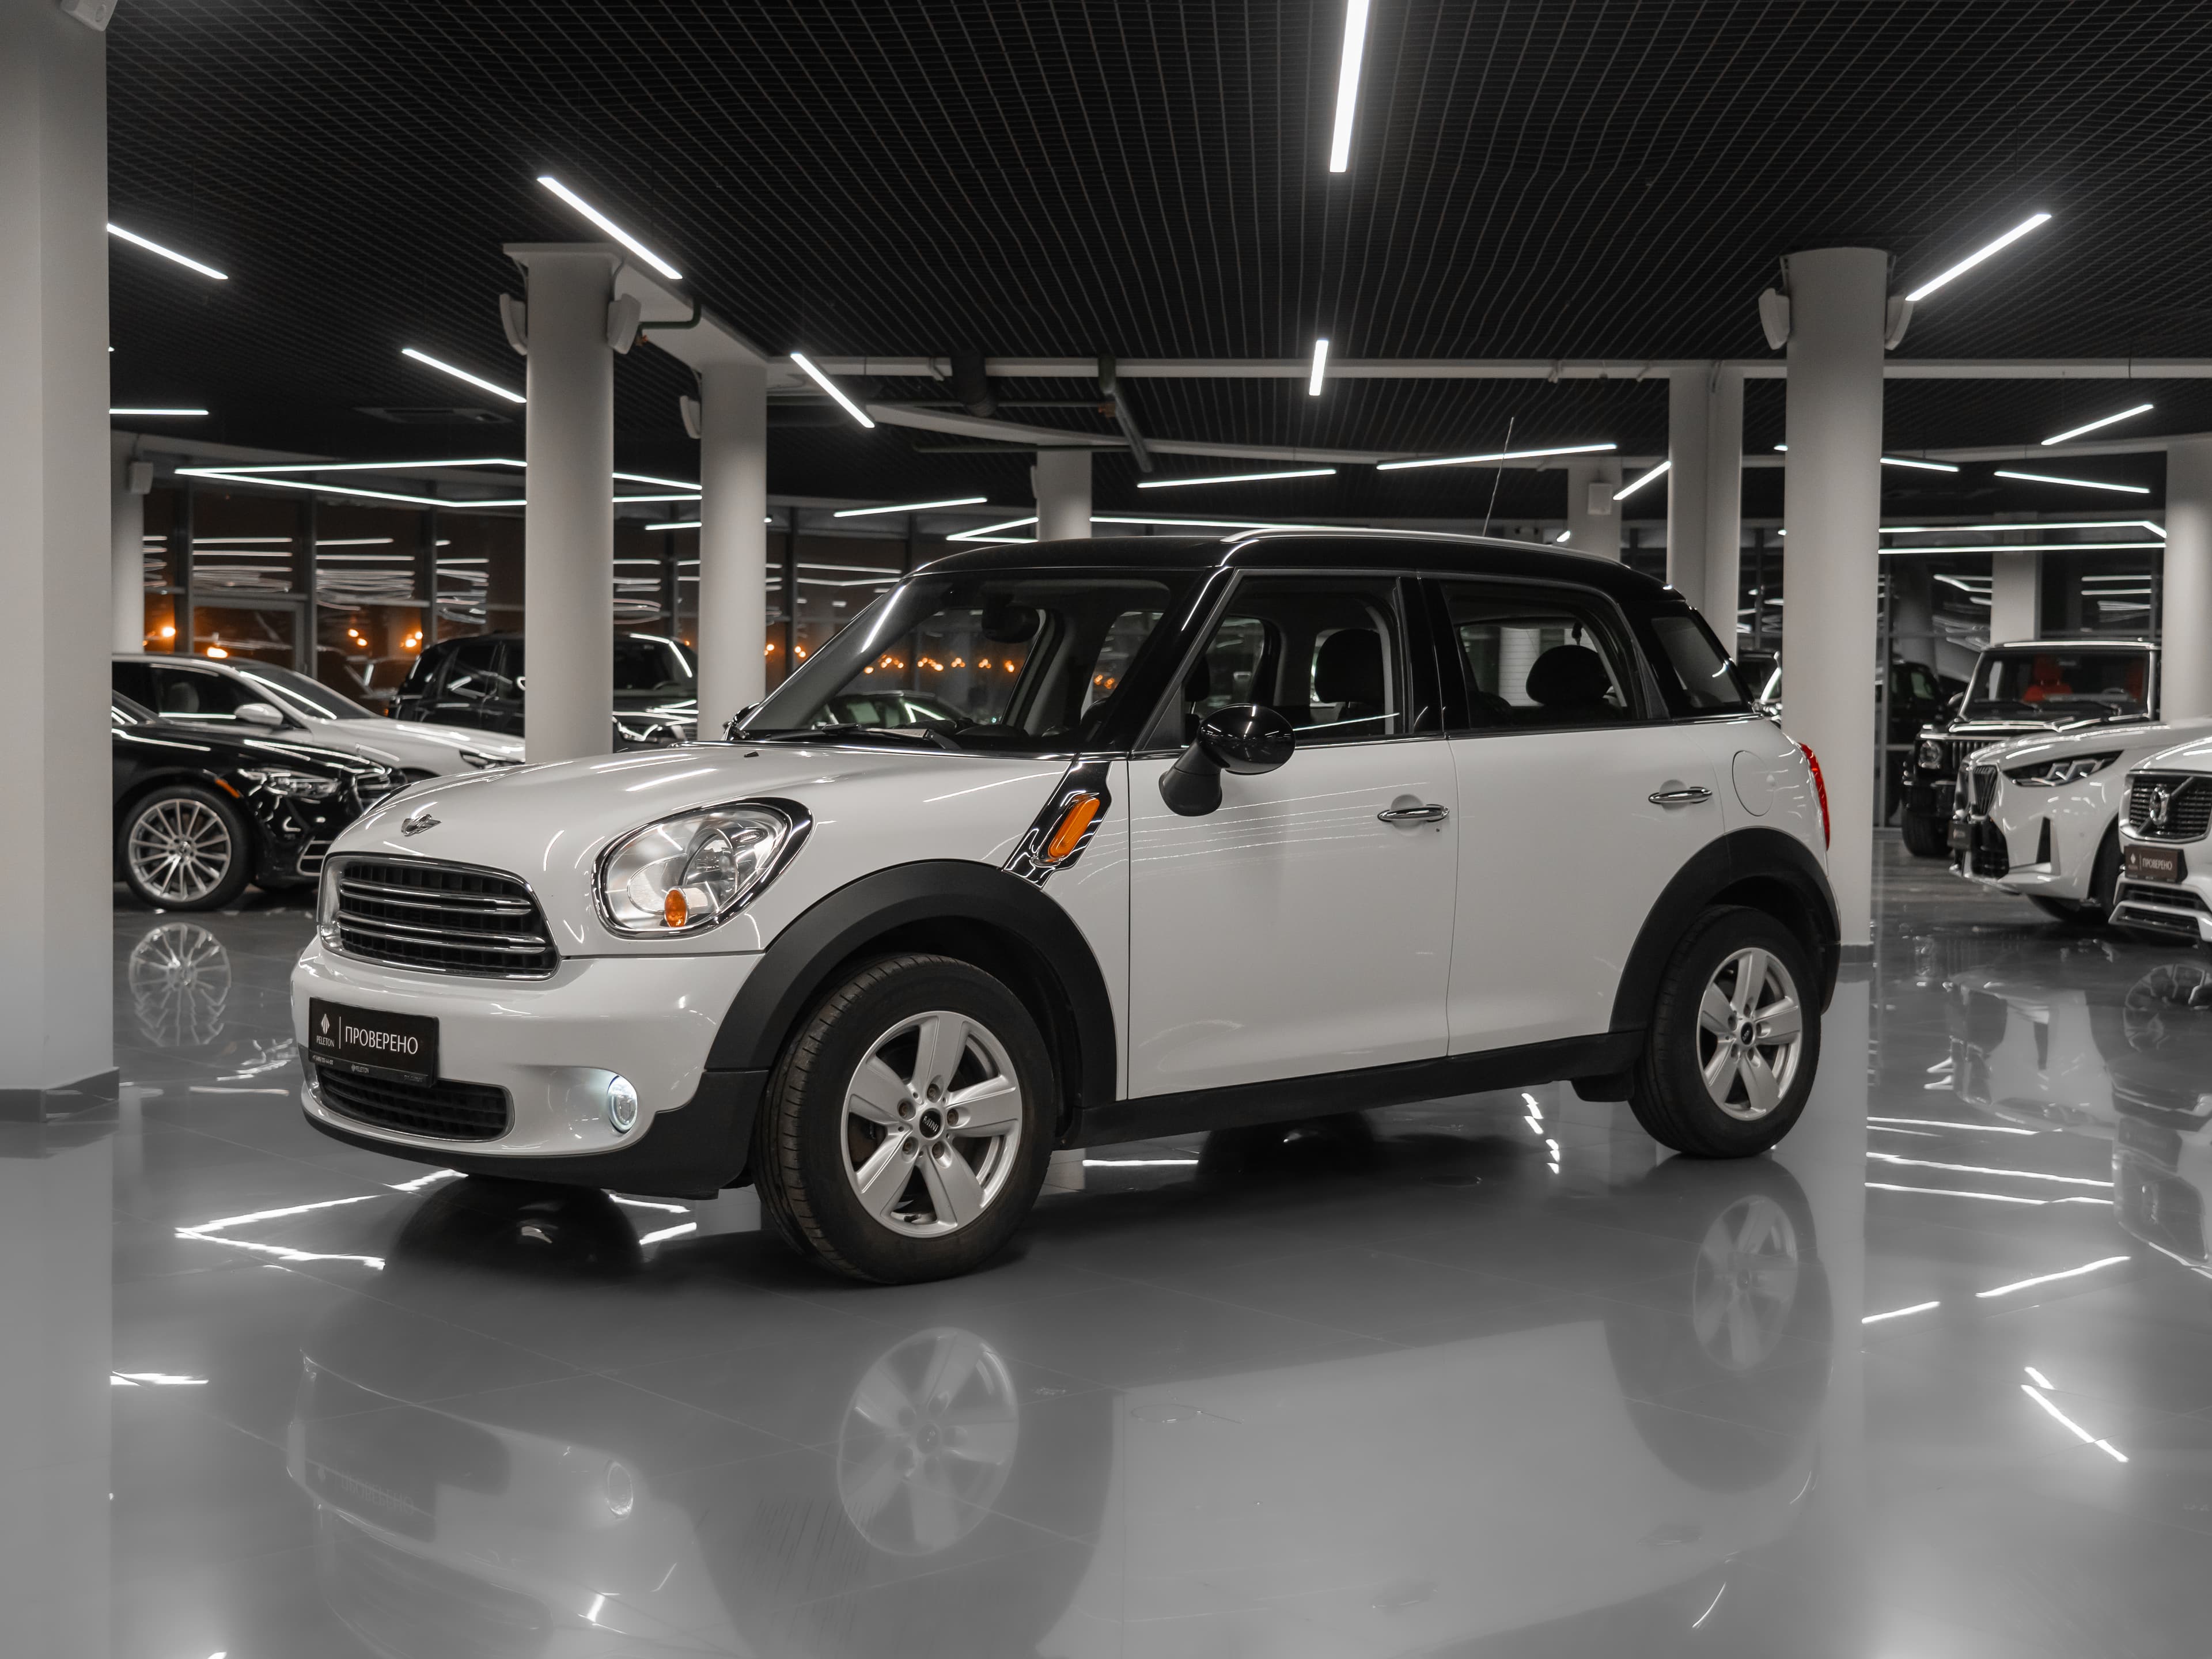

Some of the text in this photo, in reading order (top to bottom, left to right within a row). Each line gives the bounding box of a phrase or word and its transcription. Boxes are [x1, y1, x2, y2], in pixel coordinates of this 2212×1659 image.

[2142, 858, 2172, 870] ПРОВЕРЕНО
[316, 1035, 335, 1047] PELETON
[346, 1026, 418, 1054] ПРОВЕРЕНО
[922, 1115, 939, 1132] MINI
